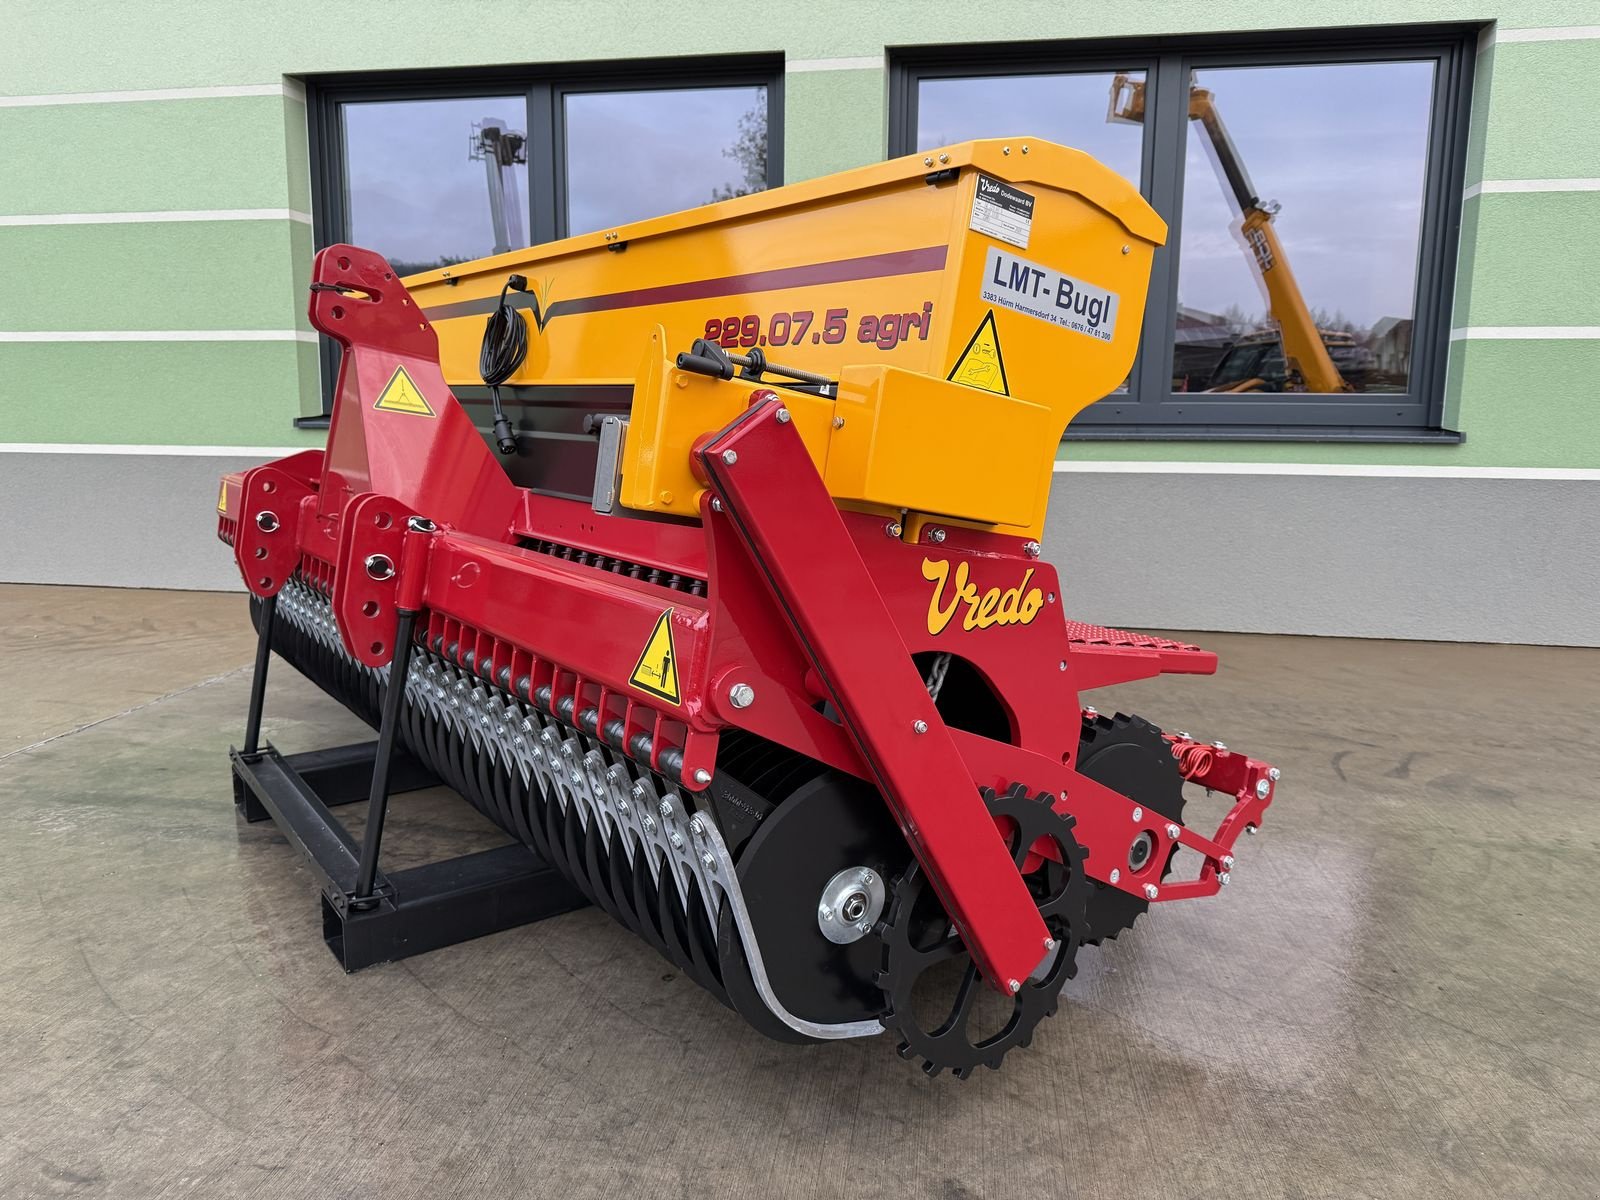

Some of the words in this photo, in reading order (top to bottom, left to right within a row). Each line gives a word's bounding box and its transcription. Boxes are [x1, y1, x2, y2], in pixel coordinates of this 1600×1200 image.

[981, 178, 1000, 193] Vredo
[983, 291, 997, 302] 3383
[1014, 302, 1050, 322] Harmersdorf
[1050, 313, 1057, 322] 34
[1071, 321, 1084, 332] 0676
[1087, 326, 1094, 336] 47
[993, 256, 1050, 298] LMT-
[1055, 278, 1111, 328] Bugl
[704, 308, 848, 348] 229.07.5
[857, 301, 933, 351] agri
[922, 557, 1045, 637] Vredo
